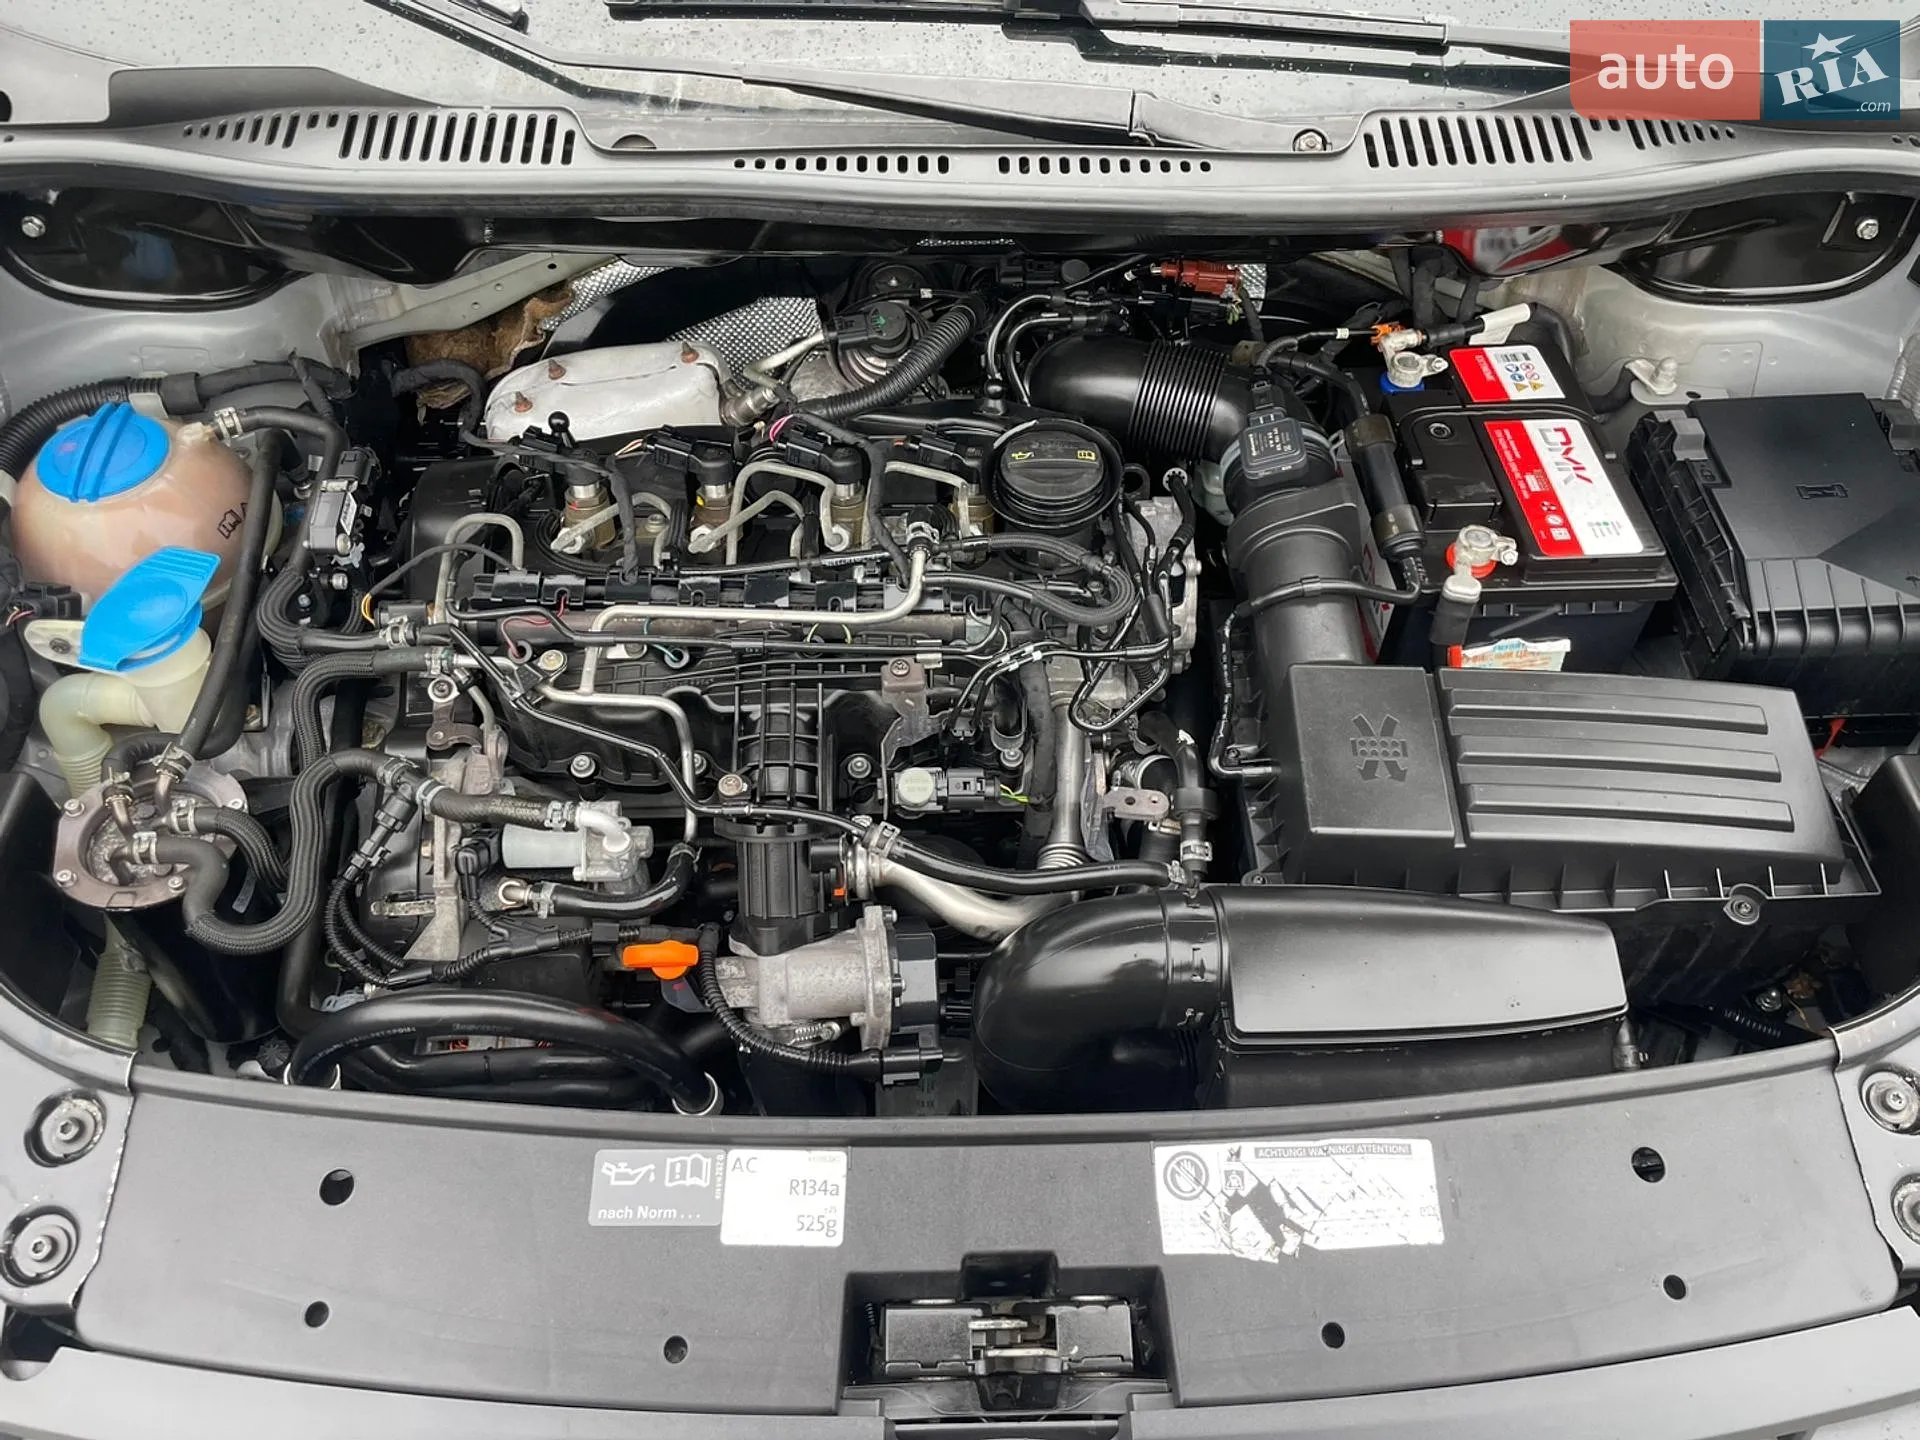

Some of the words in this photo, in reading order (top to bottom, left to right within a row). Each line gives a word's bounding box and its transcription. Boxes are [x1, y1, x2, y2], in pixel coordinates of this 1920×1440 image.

[1258, 1147, 1305, 1158] ACHTUNG!
[1356, 1144, 1410, 1155] ATTENTION!
[731, 1157, 758, 1173] AC
[789, 1179, 840, 1197] R134a
[598, 1206, 633, 1219] nach
[796, 1215, 837, 1238] 525g
